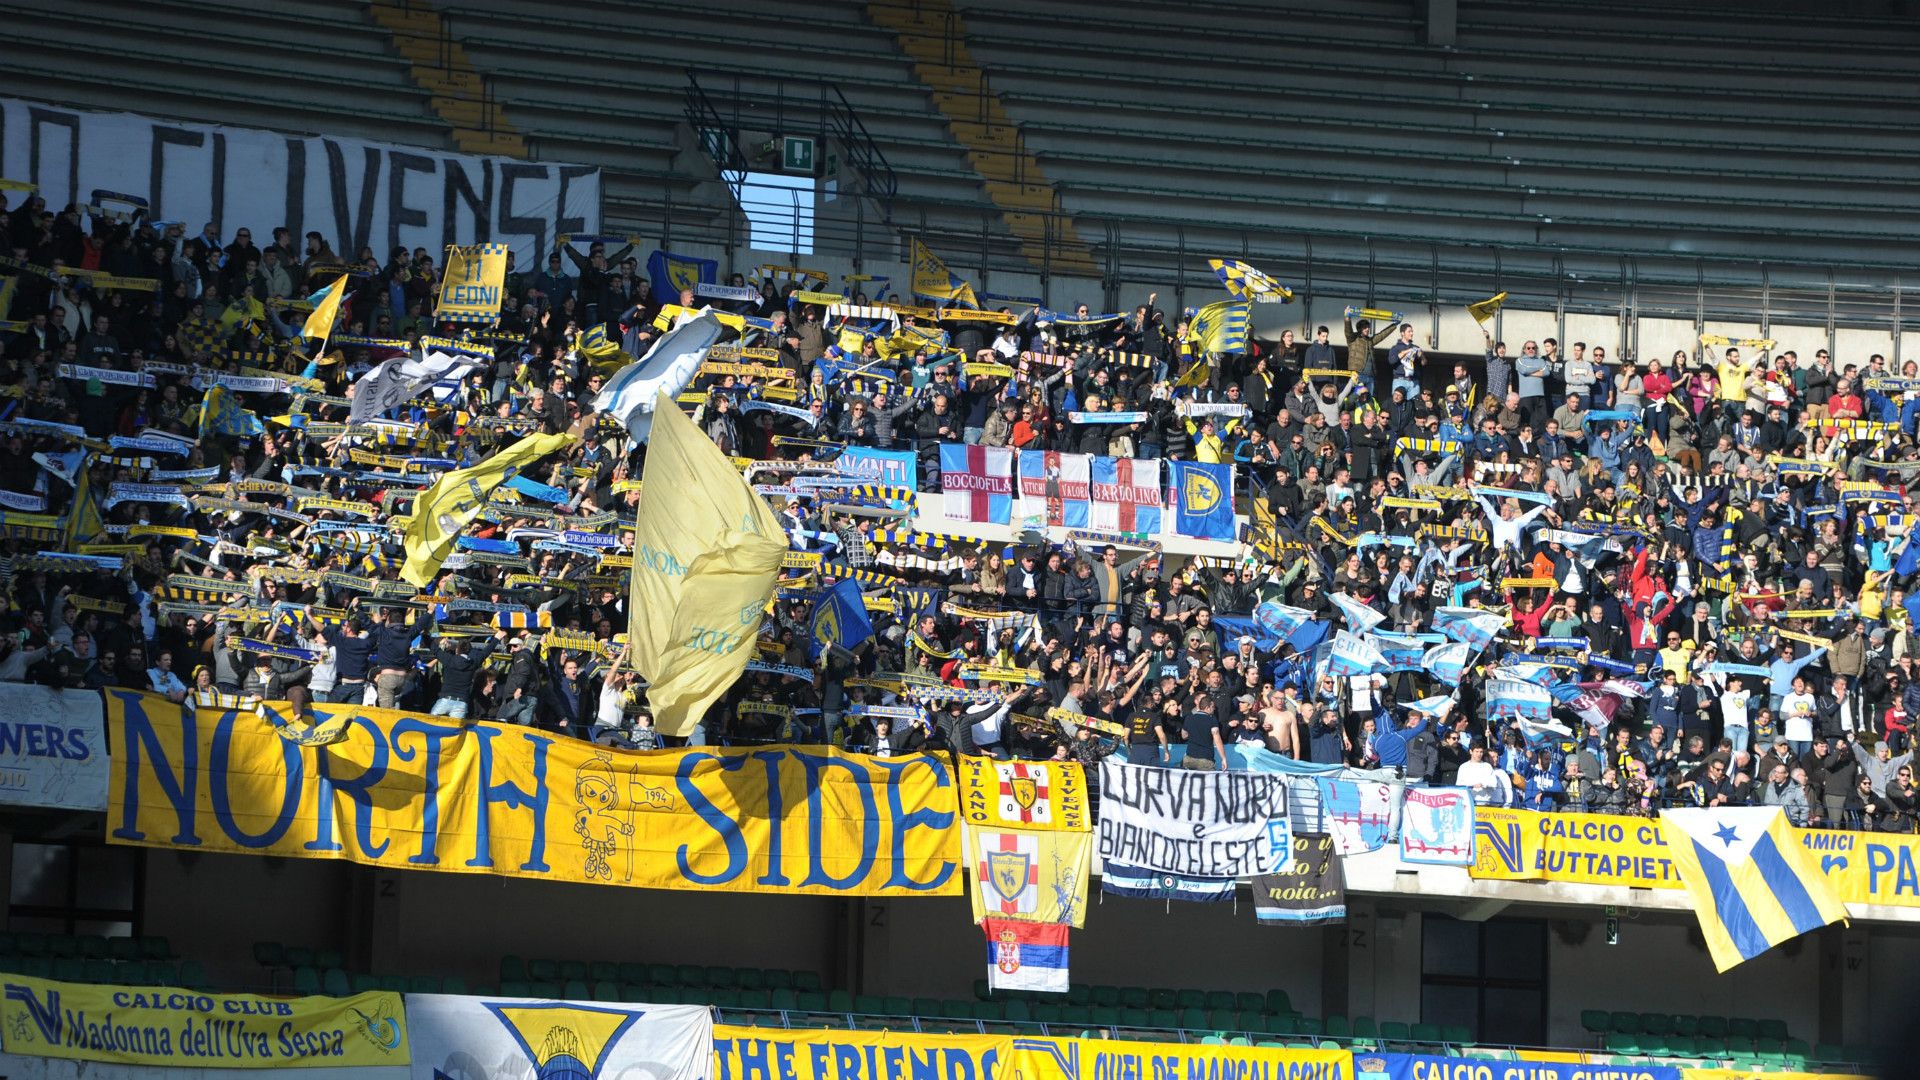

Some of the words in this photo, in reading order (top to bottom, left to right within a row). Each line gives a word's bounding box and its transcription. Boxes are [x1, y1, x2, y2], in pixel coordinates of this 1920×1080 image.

[465, 259, 482, 282] 11
[442, 284, 498, 306] LEONI
[237, 482, 276, 492] CHIEVO
[943, 474, 1012, 492] BOCCIOFILA
[1061, 483, 1088, 499] VALORI
[1092, 483, 1160, 506] BARDOLINO
[780, 560, 817, 568] CHIEVO
[112, 691, 555, 873] NORTH
[676, 750, 959, 891] SIDE
[645, 790, 667, 804] 1994
[964, 758, 988, 822] MILANO
[1057, 764, 1082, 829] CLIVENSE
[1215, 773, 1288, 825] NORD
[1539, 817, 1624, 843] CALCIO
[1099, 818, 1270, 878] BIANCOCELESTE
[1803, 833, 1854, 852] AMICI
[112, 991, 214, 1014] CALCIO
[222, 998, 293, 1017] CLUB
[65, 1008, 171, 1056] Madonna
[180, 1008, 267, 1059] dell'Uva
[278, 1021, 344, 1060] Secca
[713, 1038, 798, 1080] THE
